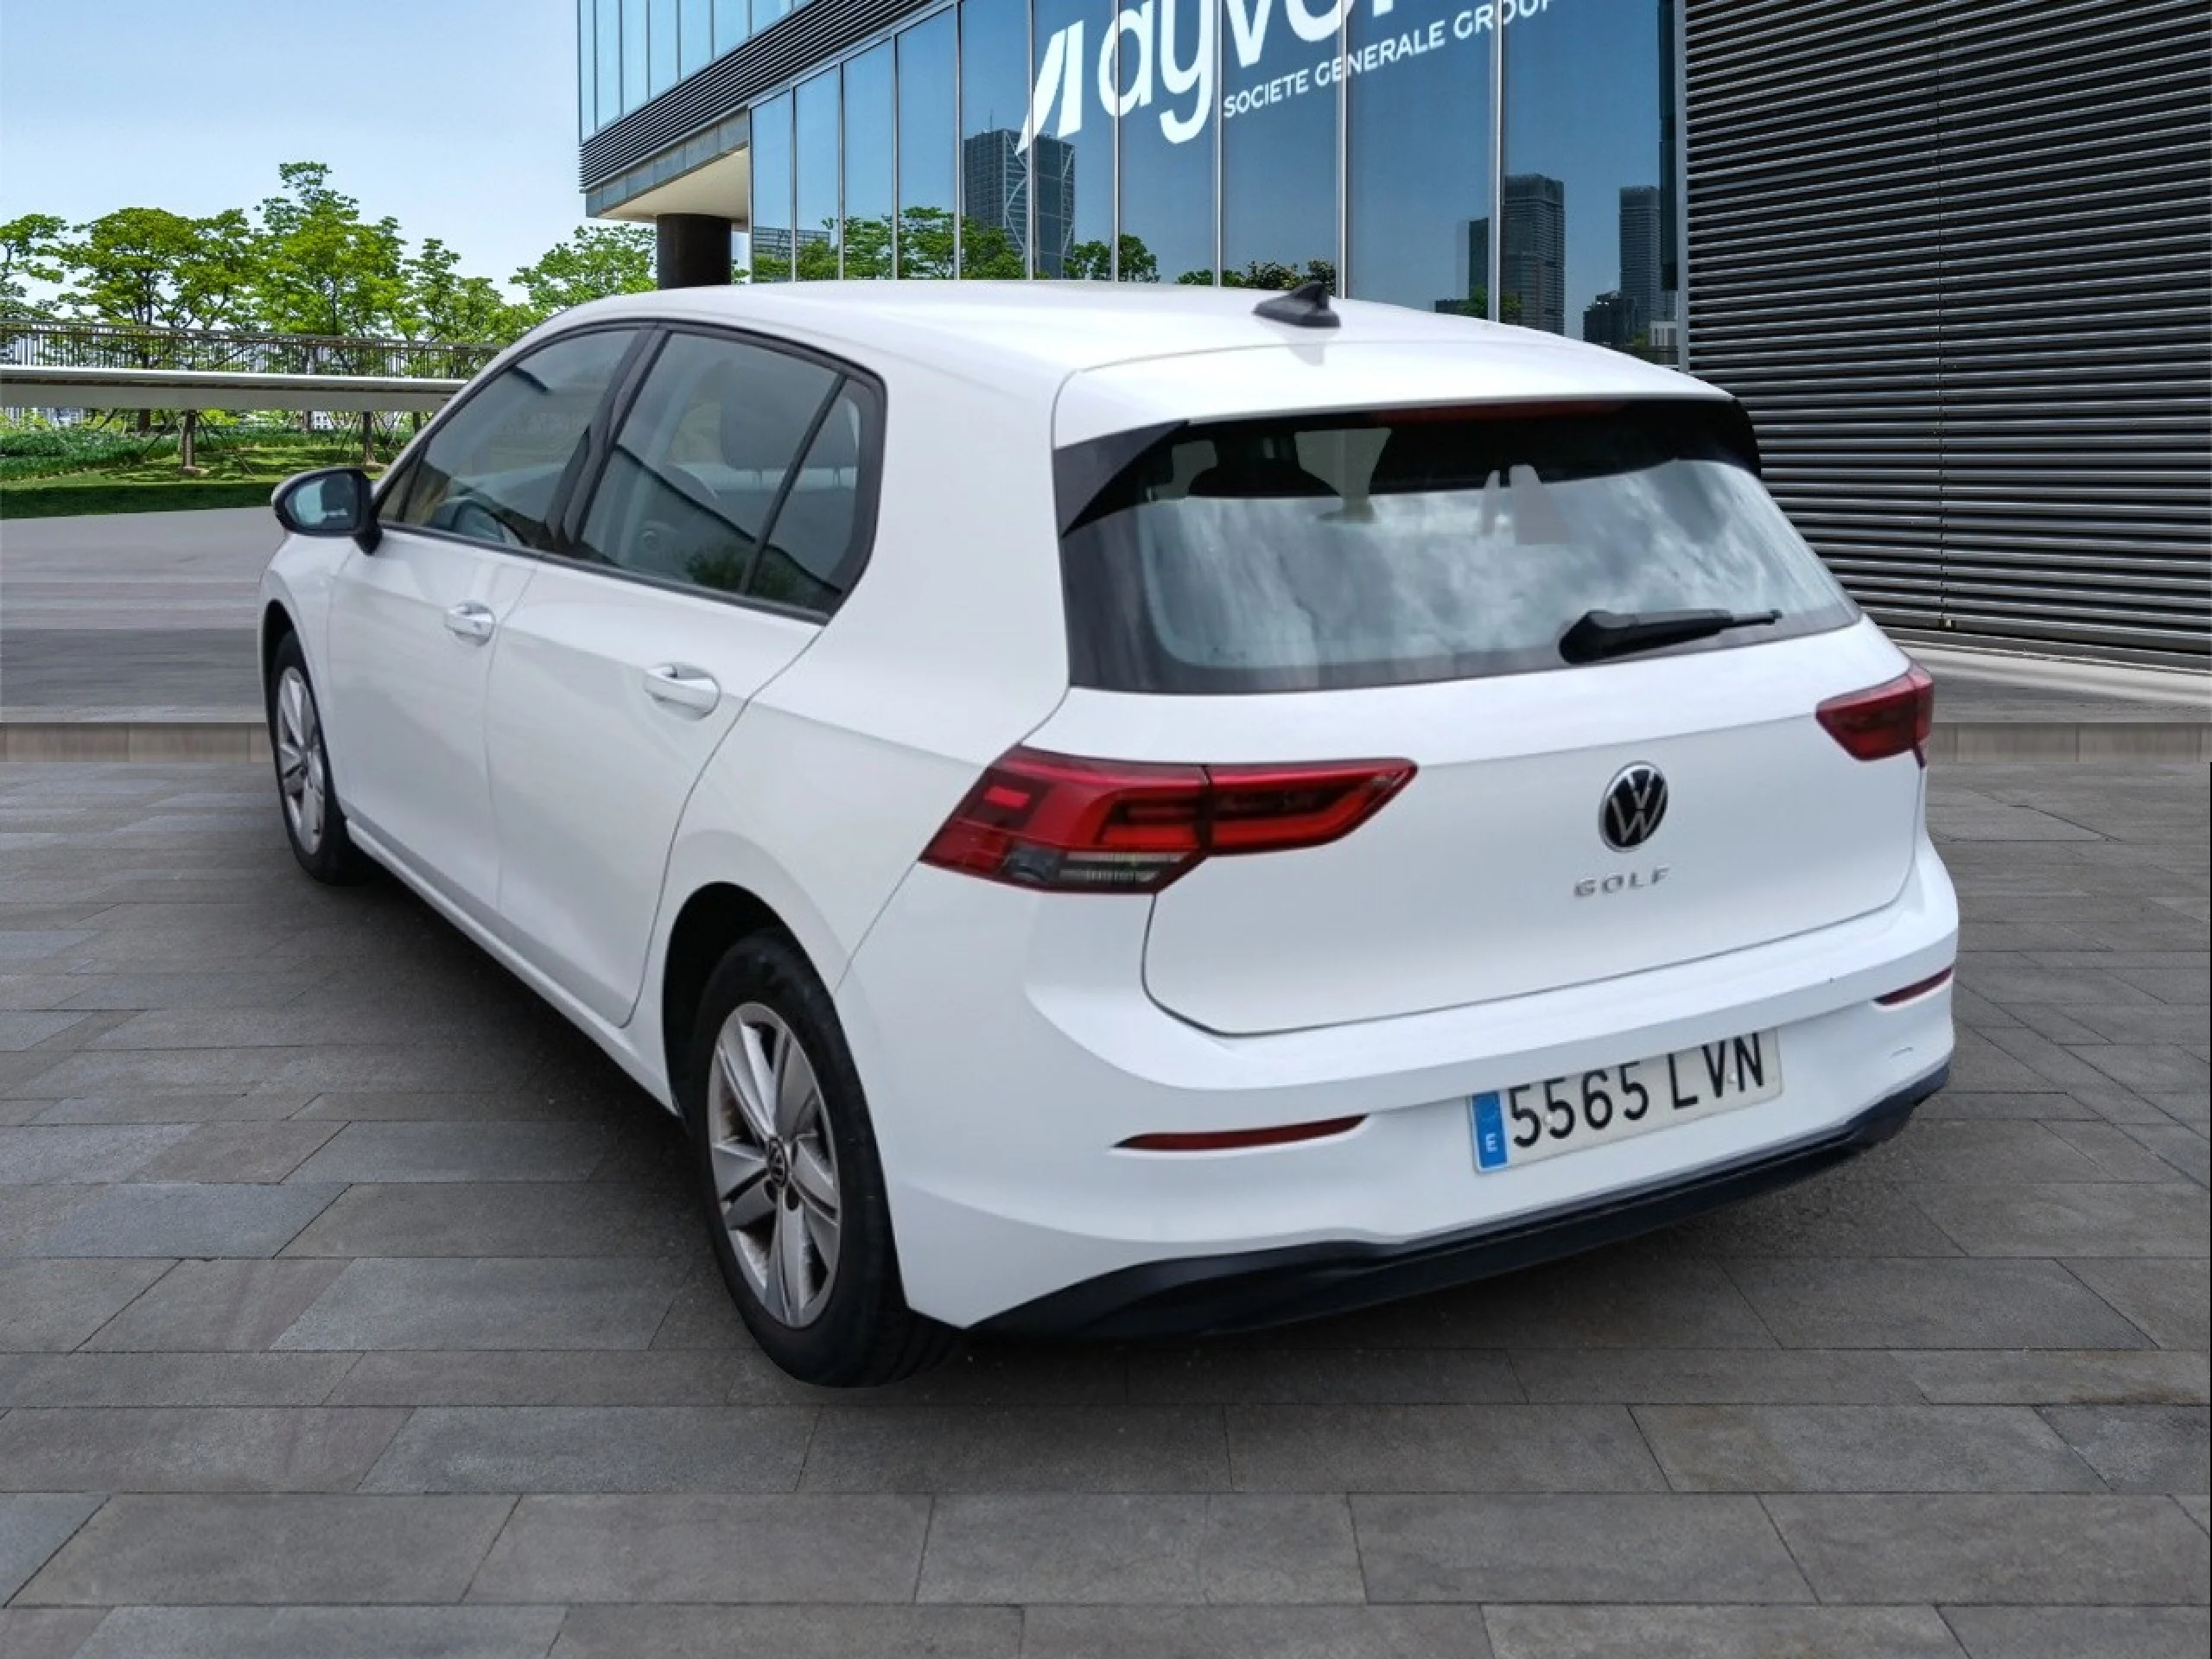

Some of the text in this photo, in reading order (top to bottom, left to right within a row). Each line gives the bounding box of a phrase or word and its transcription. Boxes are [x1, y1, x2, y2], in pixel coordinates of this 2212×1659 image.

[1224, 69, 1310, 118] SOCIETE
[1314, 20, 1446, 88] GENERALE
[1573, 865, 1669, 898] GOLF
[1484, 1032, 1764, 1154] E 5565 LVN
